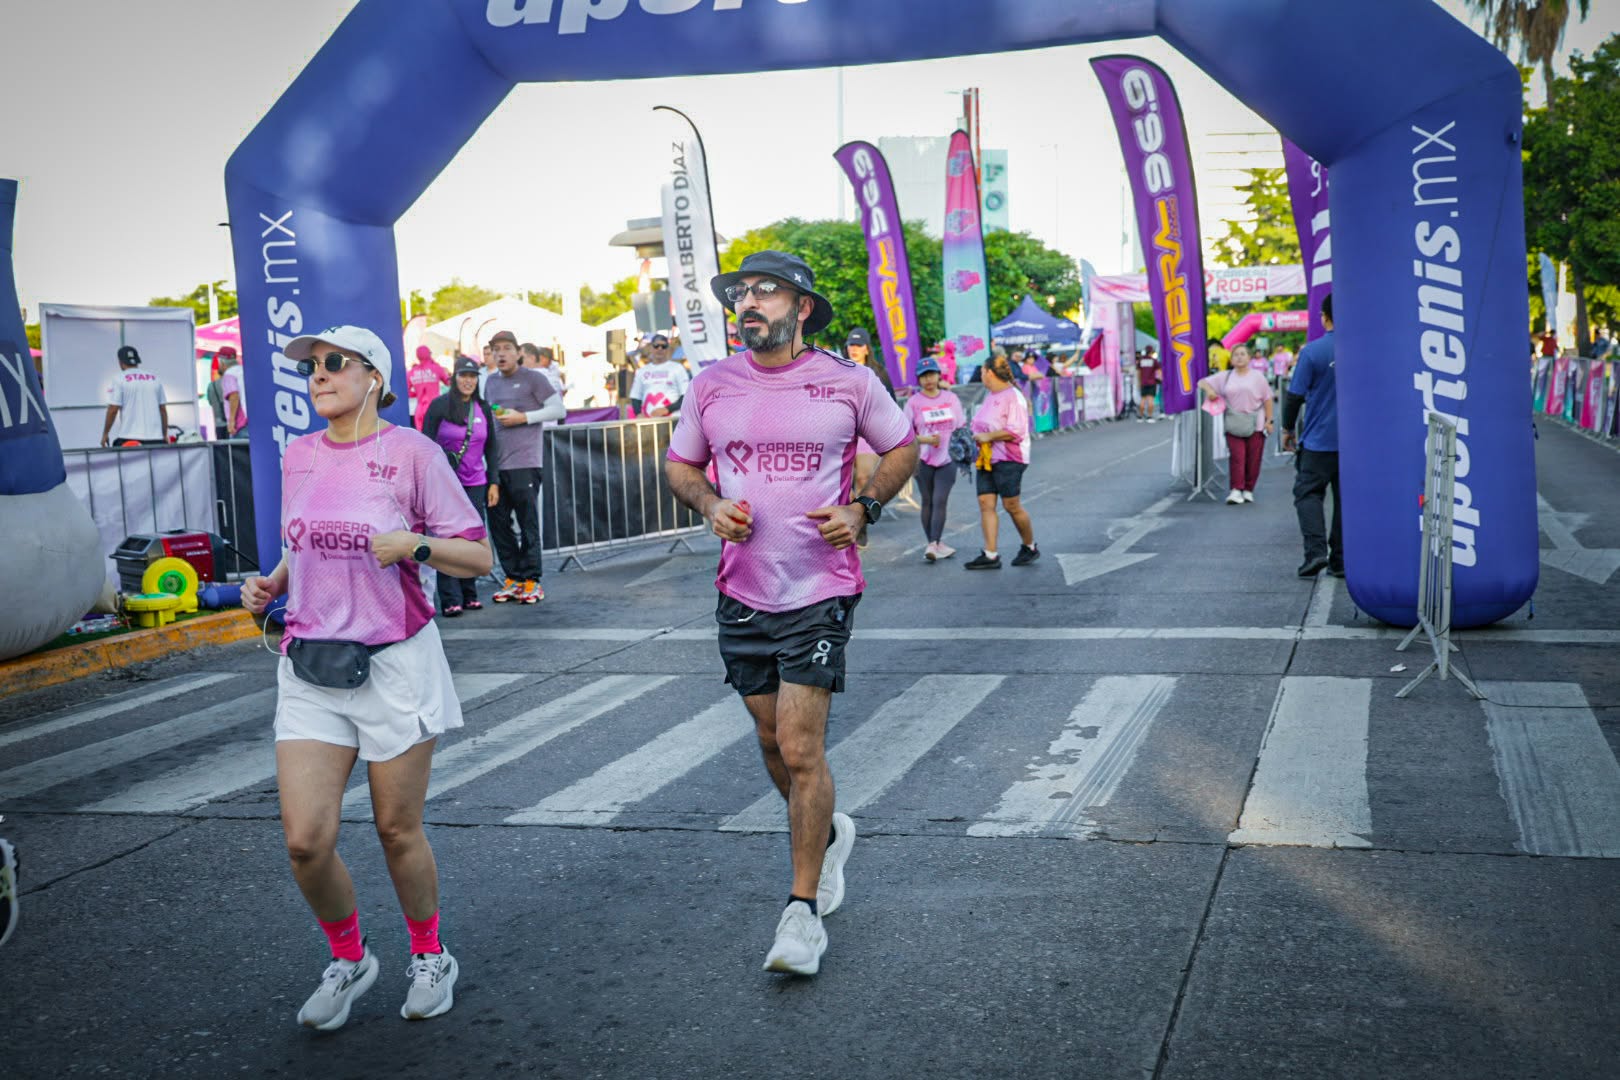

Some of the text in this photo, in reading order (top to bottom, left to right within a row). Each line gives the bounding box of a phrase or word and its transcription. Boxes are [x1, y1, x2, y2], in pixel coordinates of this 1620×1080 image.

[675, 196, 700, 293] ALBERTO
[1122, 68, 1194, 393] VIBRA 96.9
[1216, 278, 1268, 293] ROSA
[687, 299, 709, 344] LUIS
[877, 241, 909, 383] VIBRA
[259, 210, 311, 468] tenis.mx
[757, 442, 824, 453] CARRERA
[757, 453, 822, 472] ROSA
[310, 520, 370, 534] CARRERA
[310, 532, 369, 553] ROSA
